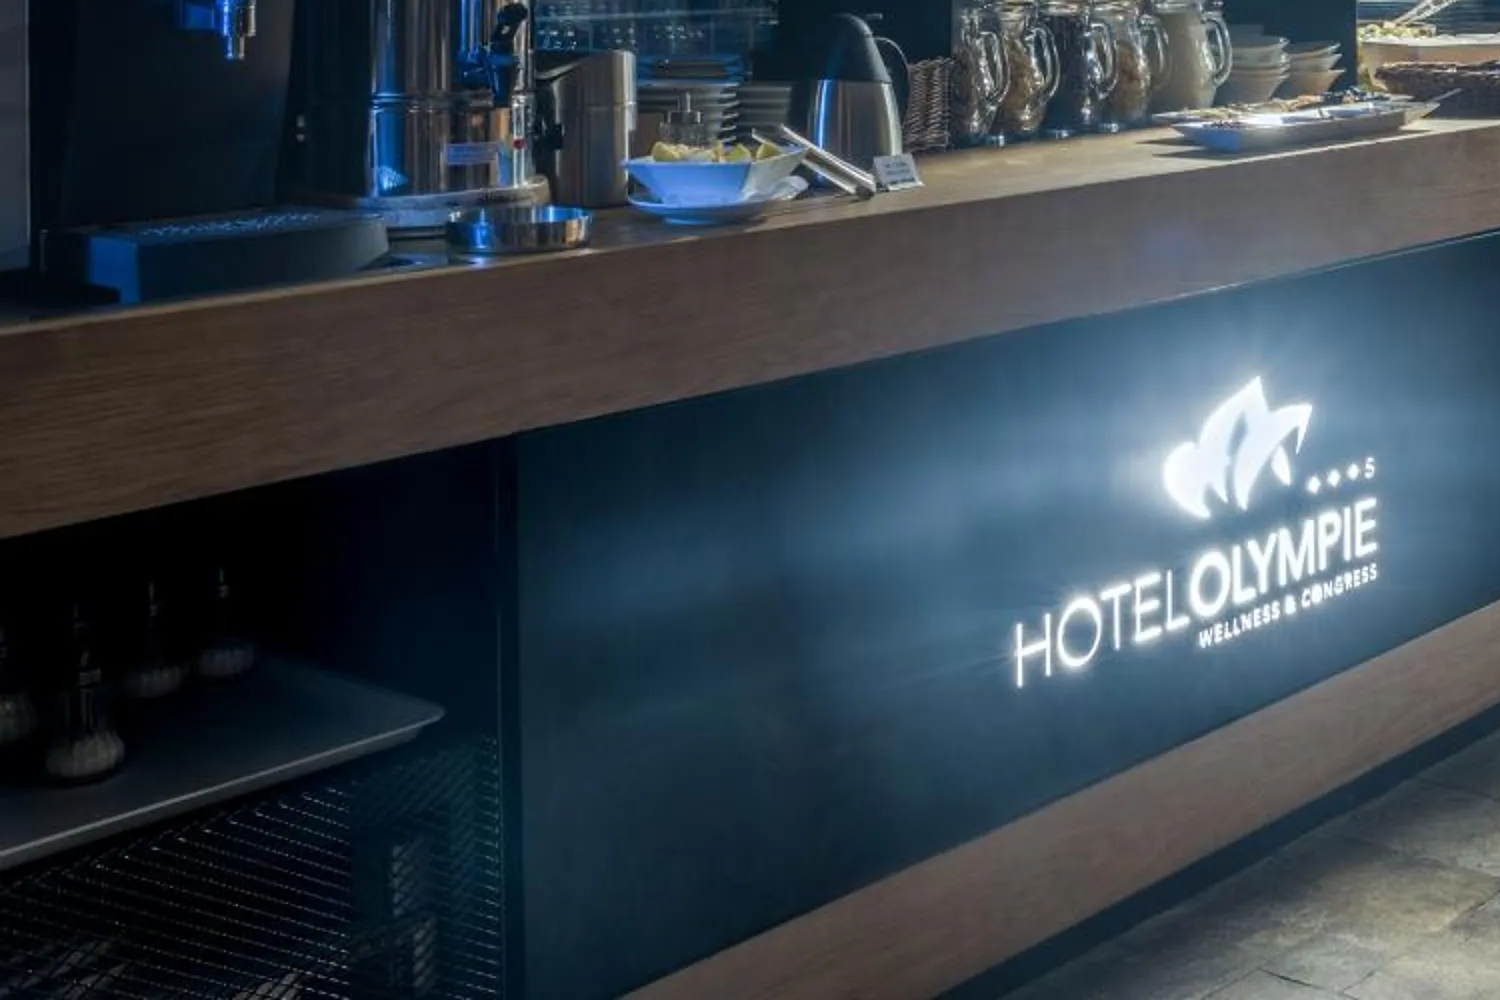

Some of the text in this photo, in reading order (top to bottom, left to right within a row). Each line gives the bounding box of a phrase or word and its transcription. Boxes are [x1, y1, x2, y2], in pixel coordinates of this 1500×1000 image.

[1014, 497, 1378, 689] HOTEL OLYMPIE
[1198, 600, 1281, 649] WELLNESS
[1301, 562, 1378, 609] CONGRESS
